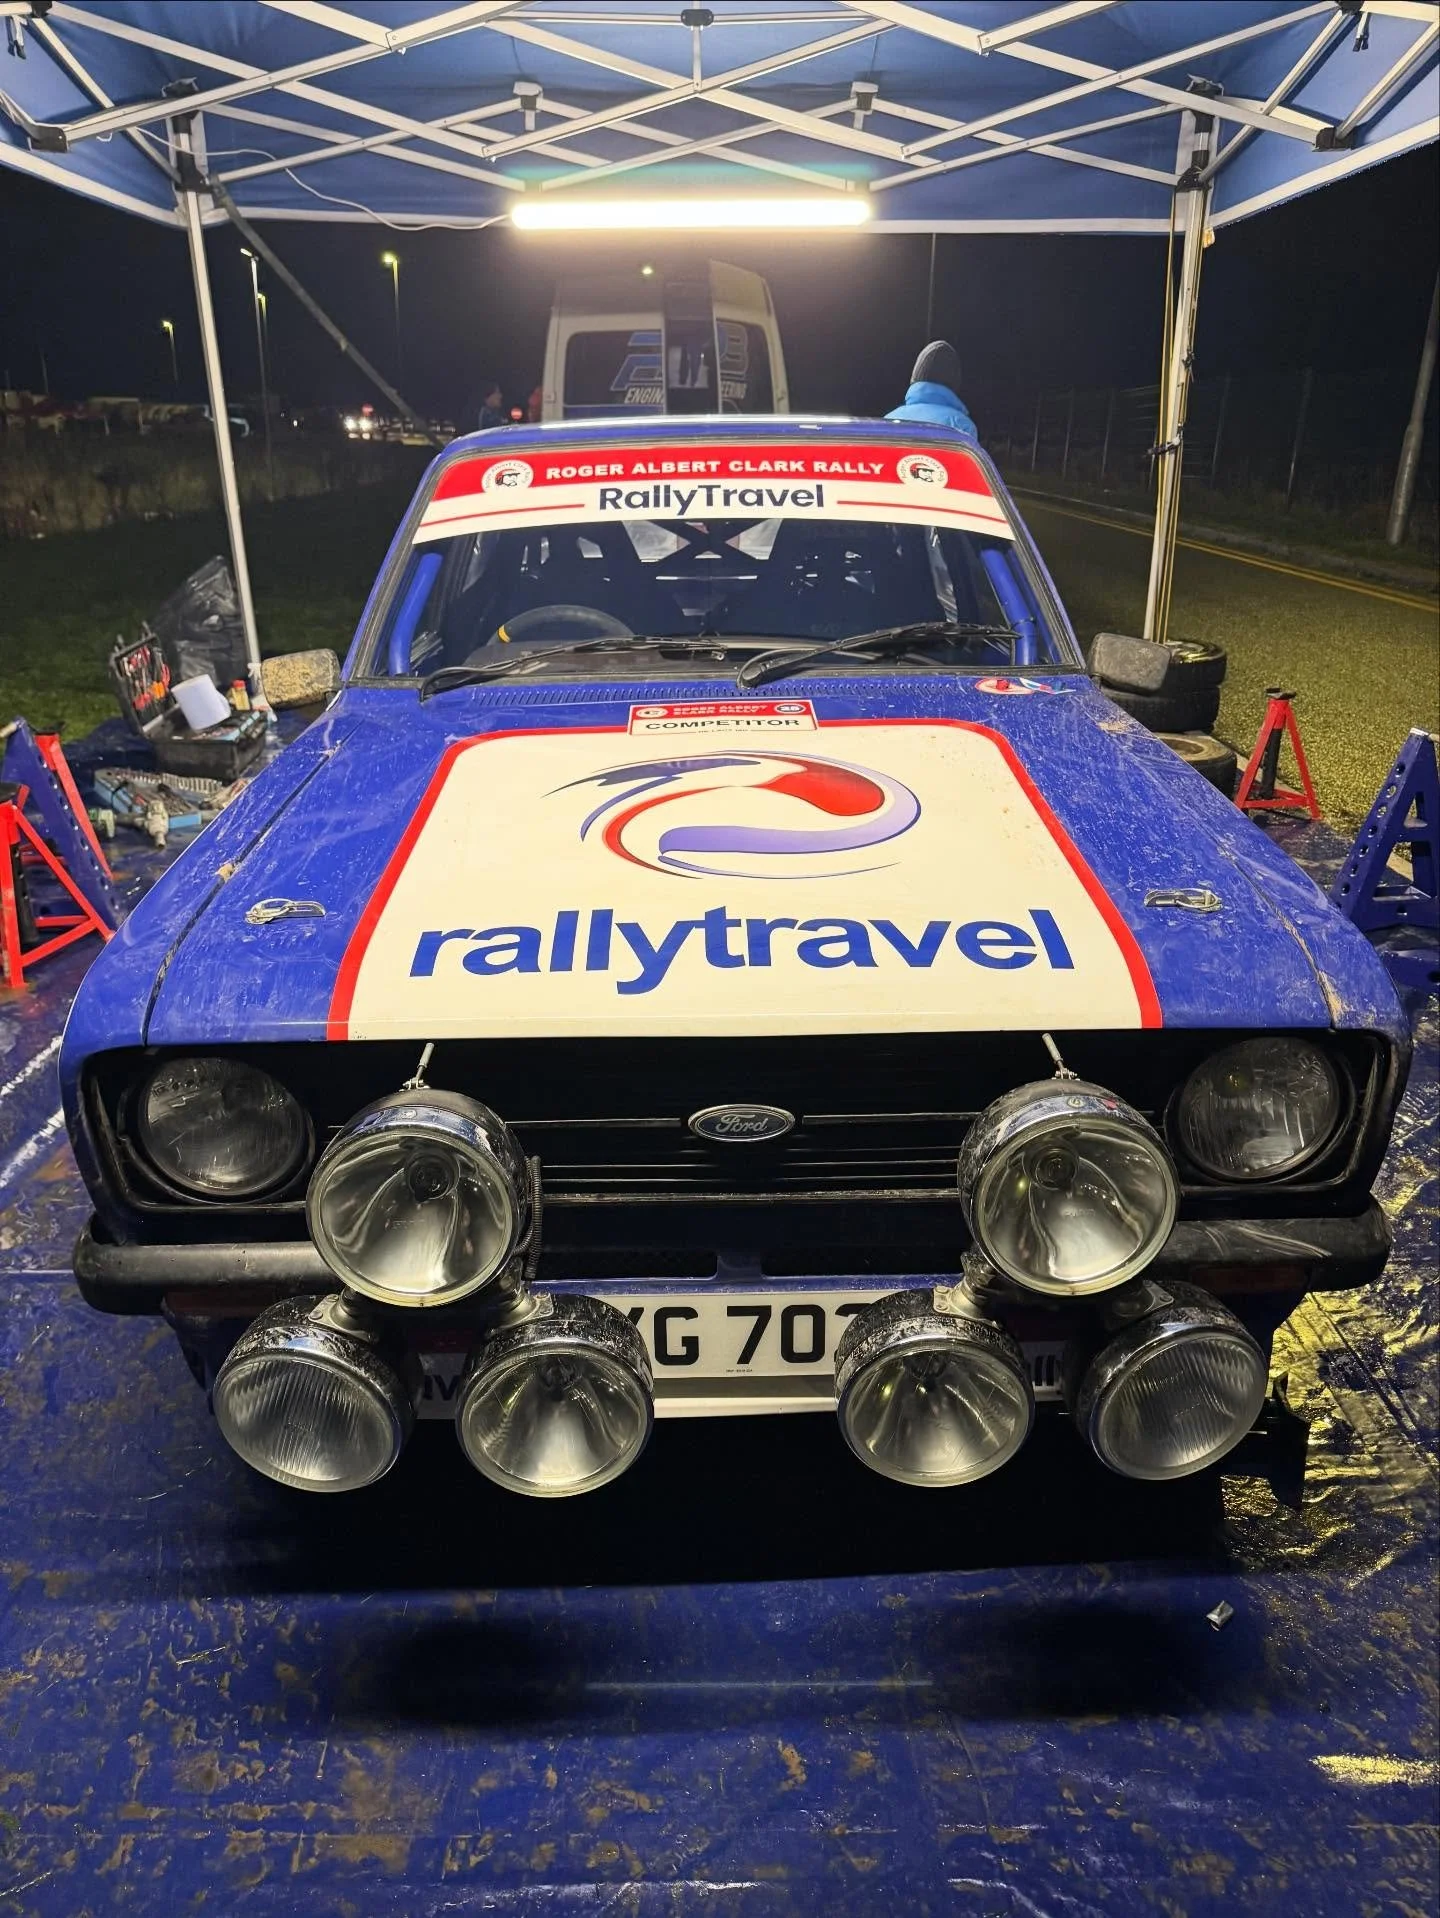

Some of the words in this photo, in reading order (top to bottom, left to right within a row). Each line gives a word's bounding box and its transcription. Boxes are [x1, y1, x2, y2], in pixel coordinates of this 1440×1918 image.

[545, 463, 624, 480] ROGER
[631, 460, 721, 475] ALBERT
[728, 460, 805, 473] CLARK
[813, 461, 885, 475] RALLY
[599, 484, 824, 516] RallyTravel
[645, 719, 800, 729] COMPETITOR
[409, 905, 1075, 995] rallytravel
[715, 1113, 768, 1133] Ford
